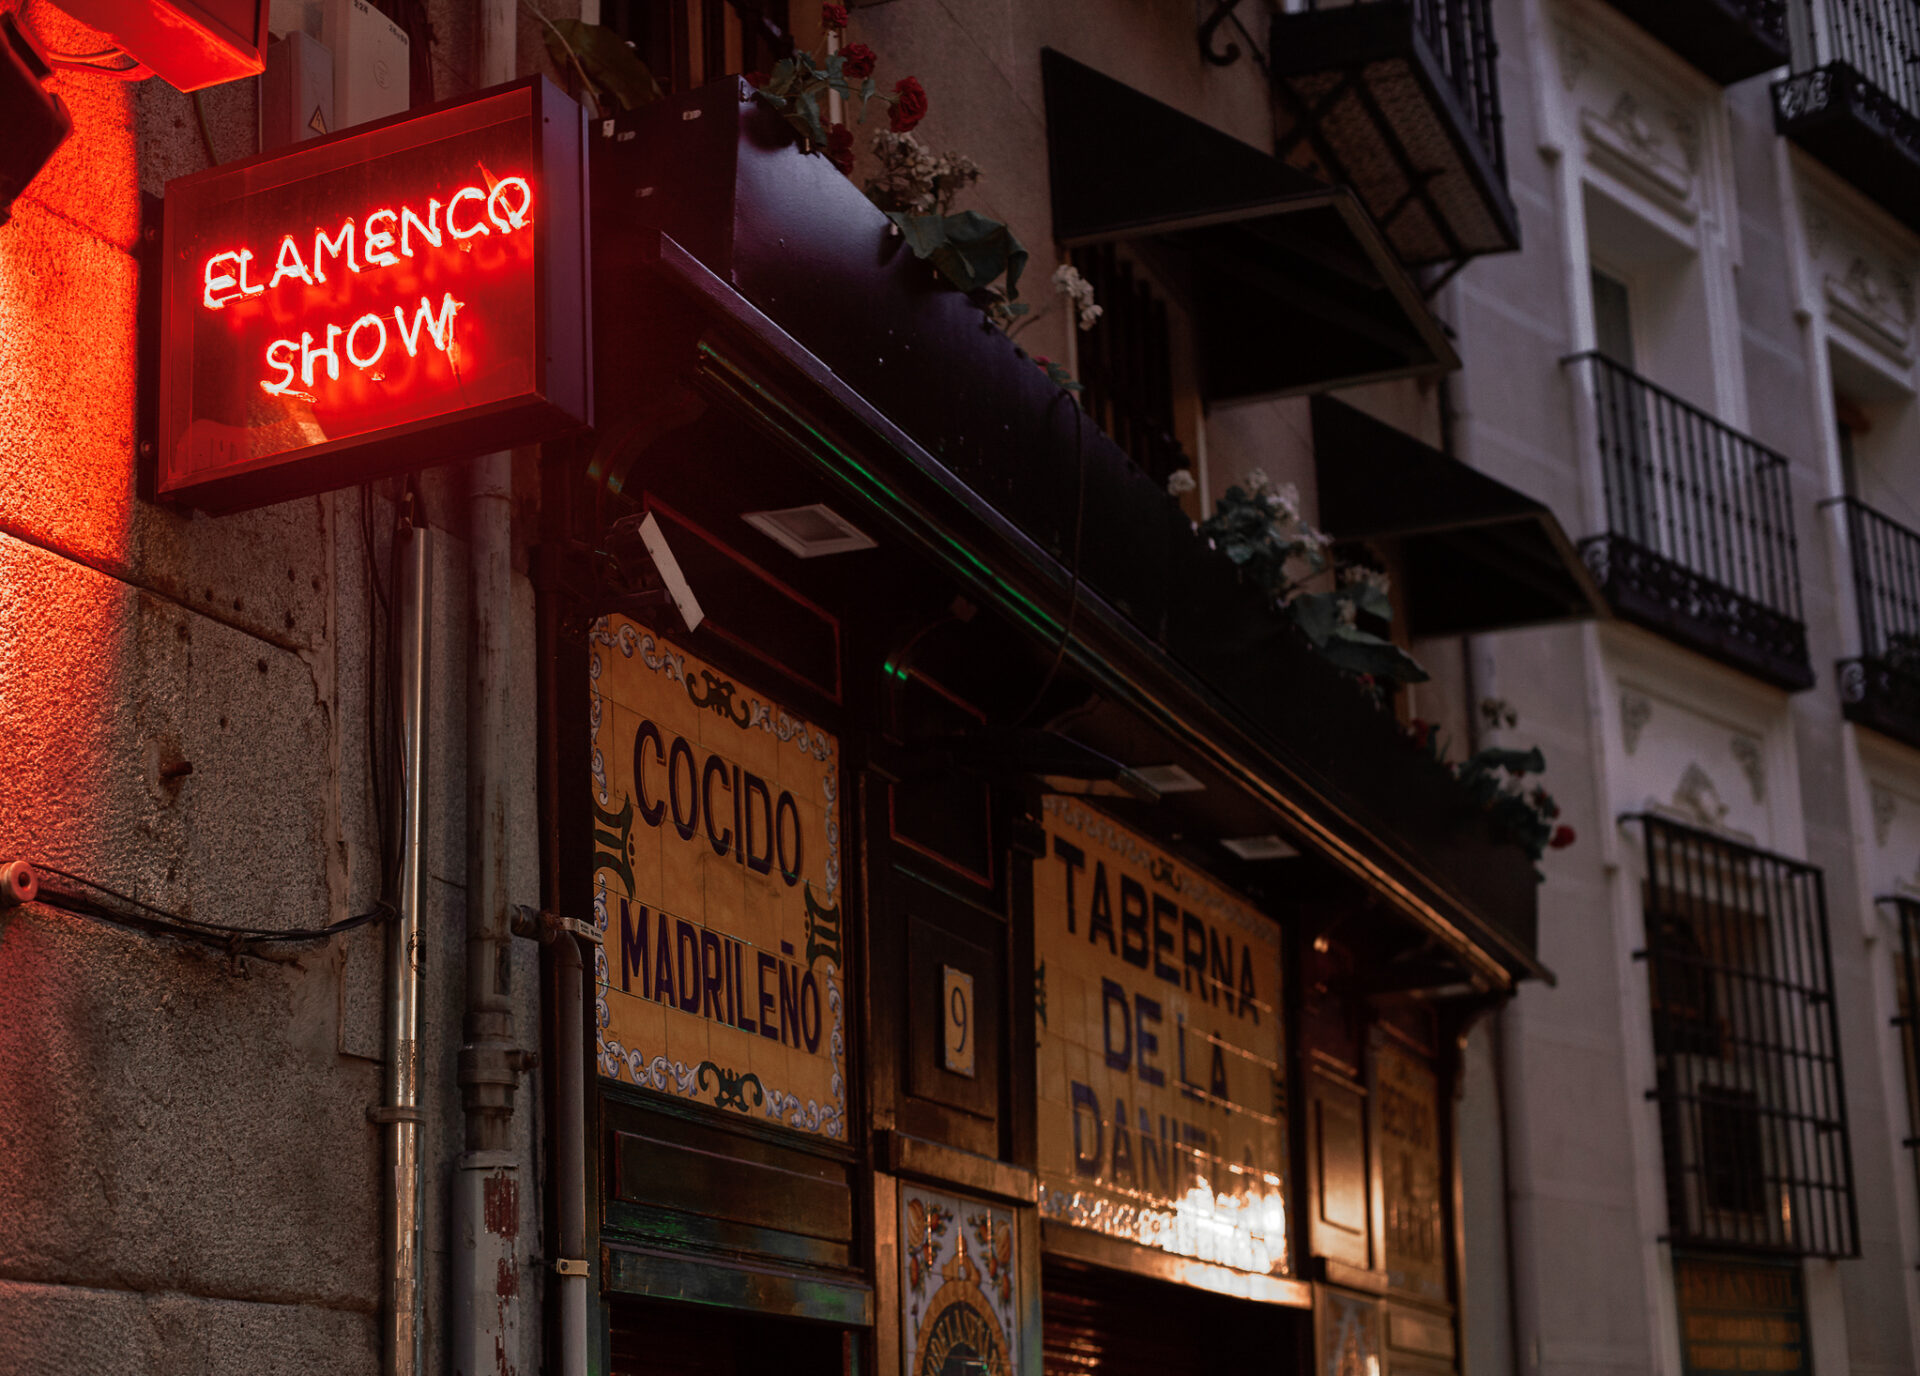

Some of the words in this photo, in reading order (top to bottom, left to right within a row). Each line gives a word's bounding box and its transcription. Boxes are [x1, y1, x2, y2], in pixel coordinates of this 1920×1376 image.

[260, 293, 460, 397] SHOW
[633, 719, 801, 887] COCIDO
[620, 897, 821, 1055] MADRILEÑO
[1053, 836, 1261, 1027] TABERNA
[949, 985, 968, 1054] 9
[1101, 975, 1166, 1088] DE
[1176, 1011, 1232, 1116] LA
